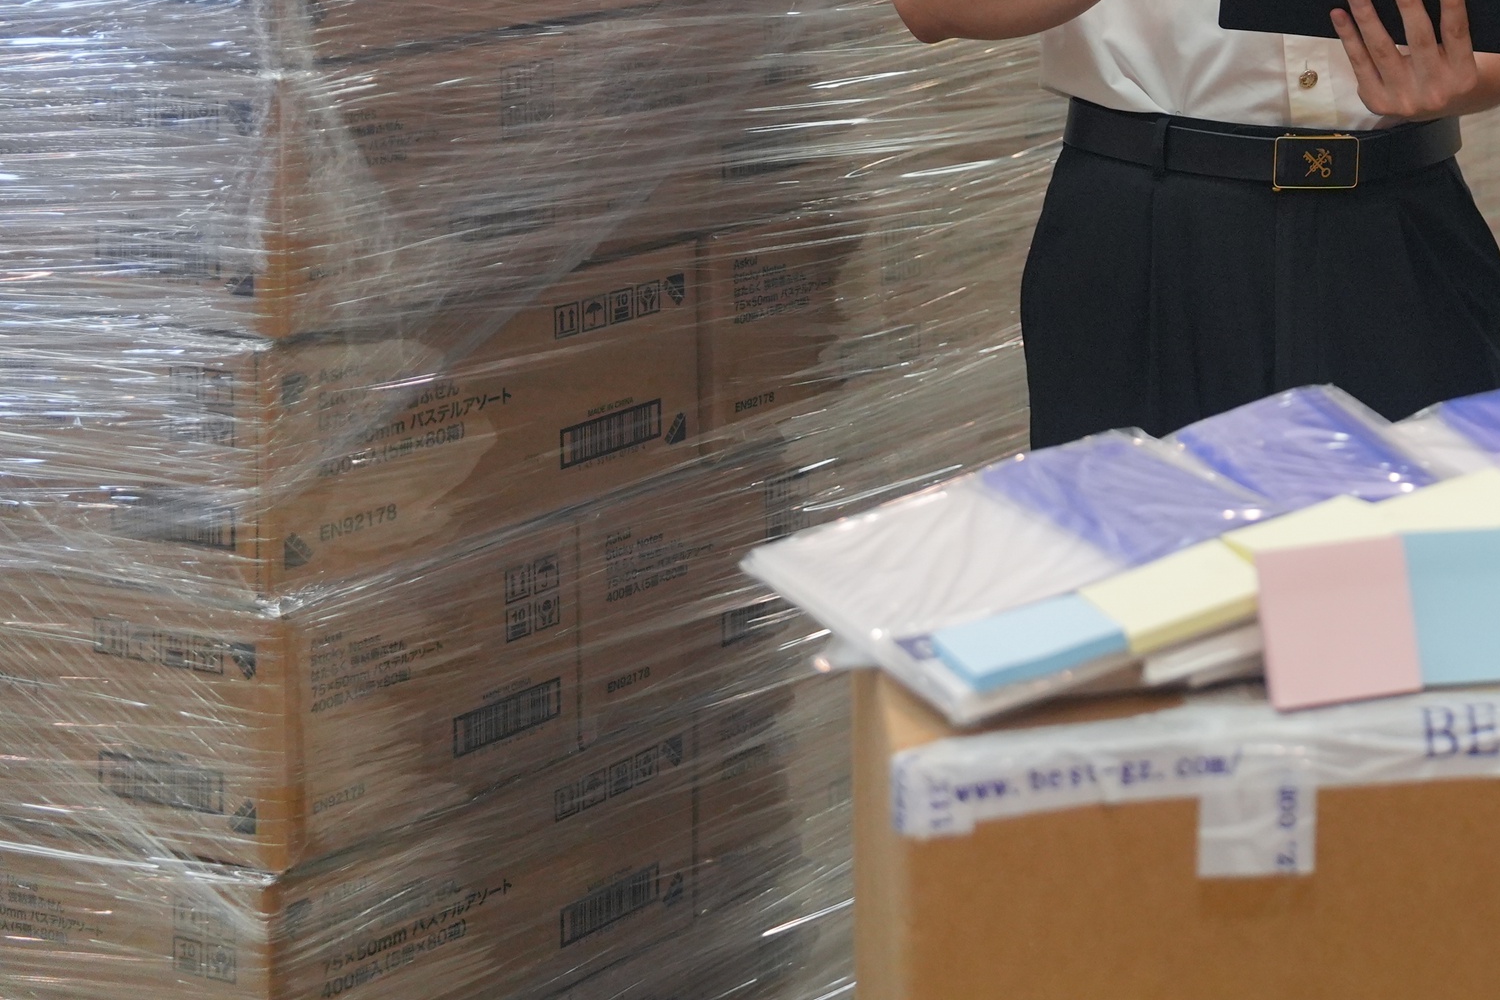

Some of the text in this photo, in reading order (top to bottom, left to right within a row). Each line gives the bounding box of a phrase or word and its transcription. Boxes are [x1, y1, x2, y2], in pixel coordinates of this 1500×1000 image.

[410, 386, 512, 430] パステルアソート
[735, 391, 775, 414] EN92178
[319, 502, 398, 542] EN92178
[607, 666, 652, 694] EN92178
[411, 878, 513, 935] パステルアソート
[31, 911, 104, 938] パステルアソート
